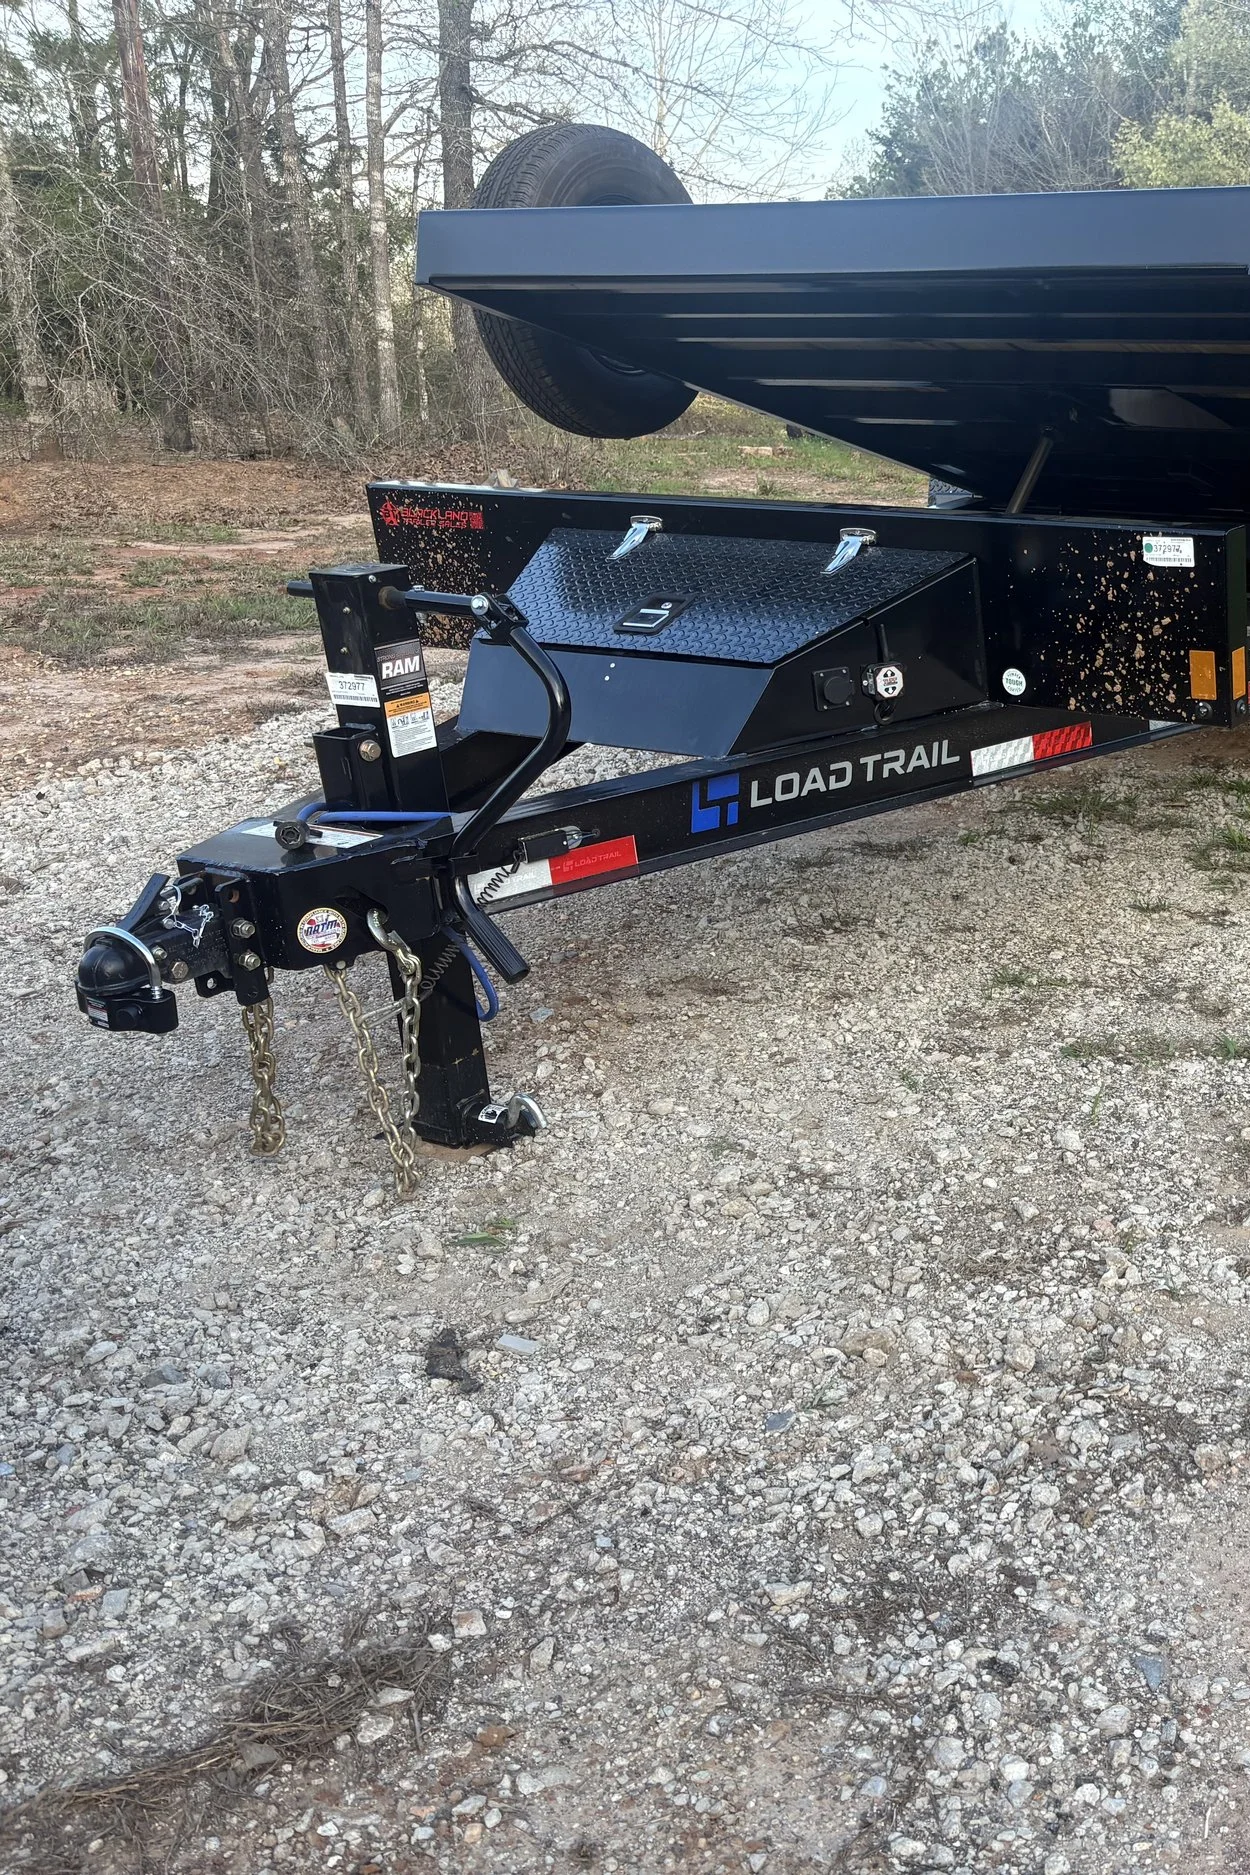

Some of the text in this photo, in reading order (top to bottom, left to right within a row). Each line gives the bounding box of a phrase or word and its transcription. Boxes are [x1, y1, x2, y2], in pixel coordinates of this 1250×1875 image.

[401, 508, 469, 521] BLACKLAND
[438, 520, 467, 529] SALES
[382, 655, 420, 679] RAM
[338, 680, 366, 692] 372977
[1005, 678, 1023, 686] TOUGH
[750, 739, 960, 809] LOAD TRAIL
[574, 850, 622, 868] LOAD TRAIL
